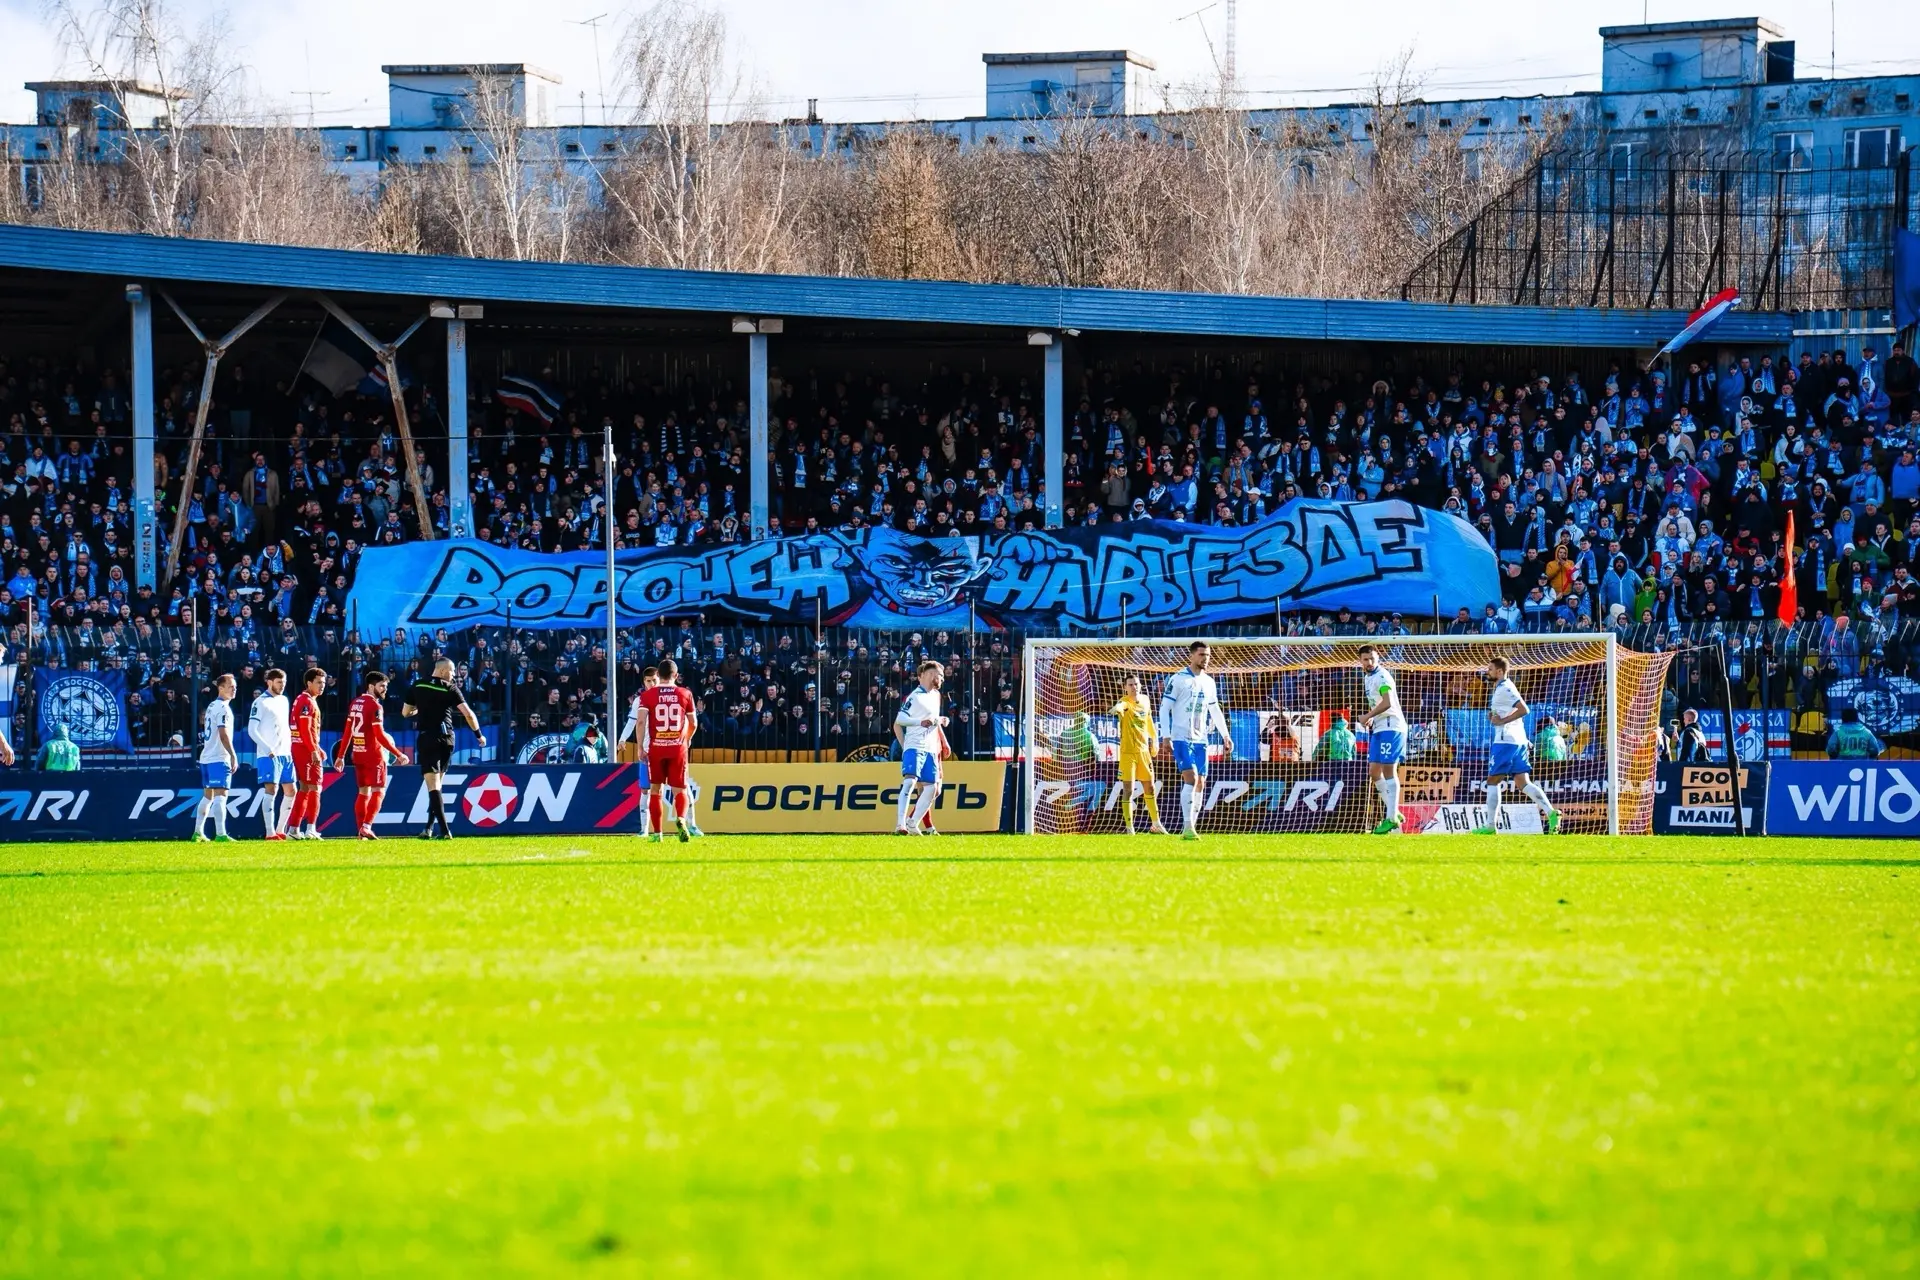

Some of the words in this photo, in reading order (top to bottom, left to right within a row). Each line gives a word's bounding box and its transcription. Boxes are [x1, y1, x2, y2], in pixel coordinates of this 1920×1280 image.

[408, 537, 850, 624] ВОРОНЕЖ
[63, 679, 101, 692] SOCCER
[655, 703, 682, 732] 99
[1700, 712, 1785, 728] ОТОЖКА
[1380, 742, 1392, 755] 52
[1404, 769, 1455, 783] FOOT
[1689, 771, 1741, 784] FOO
[371, 772, 582, 827] LEON
[1203, 780, 1345, 812] PARI
[1403, 788, 1448, 801] BALL
[1688, 790, 1734, 804] BALL
[1442, 805, 1471, 832] Red
